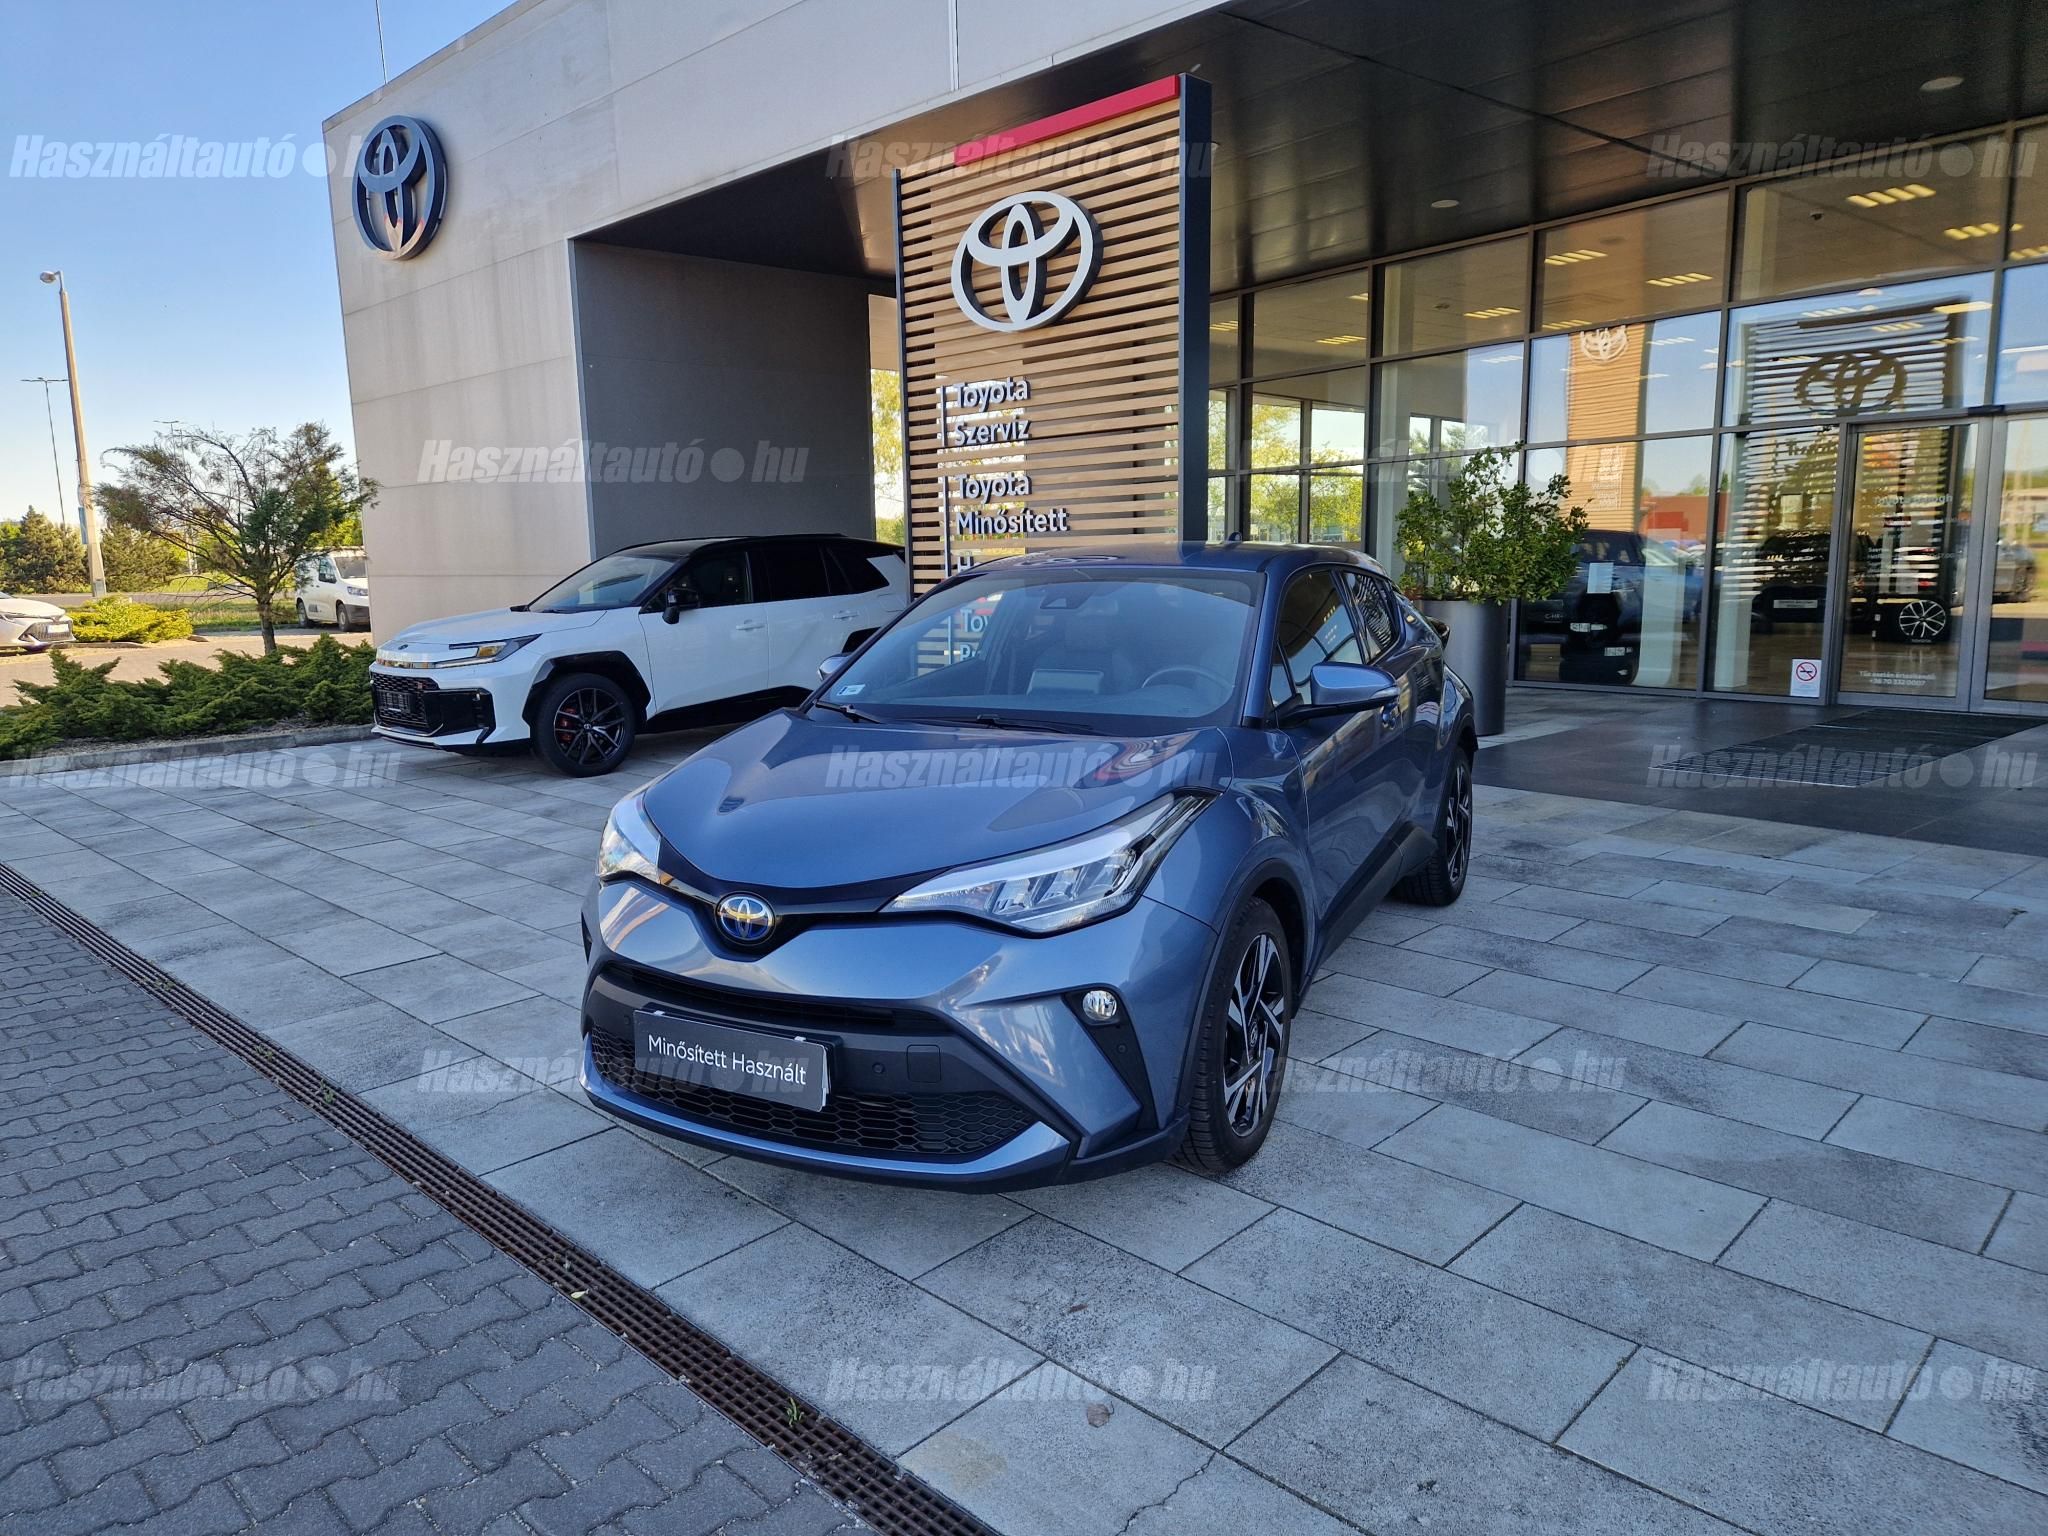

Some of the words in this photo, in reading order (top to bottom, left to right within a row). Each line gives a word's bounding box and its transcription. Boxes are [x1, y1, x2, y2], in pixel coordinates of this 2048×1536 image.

[954, 377, 1030, 411] Toyota
[955, 415, 1031, 446] Szerviz
[956, 473, 1031, 504] Toyota
[956, 509, 1069, 535] Minősített
[957, 551, 976, 573] H
[647, 1034, 728, 1069] Minősített
[732, 1052, 808, 1086] Használt
